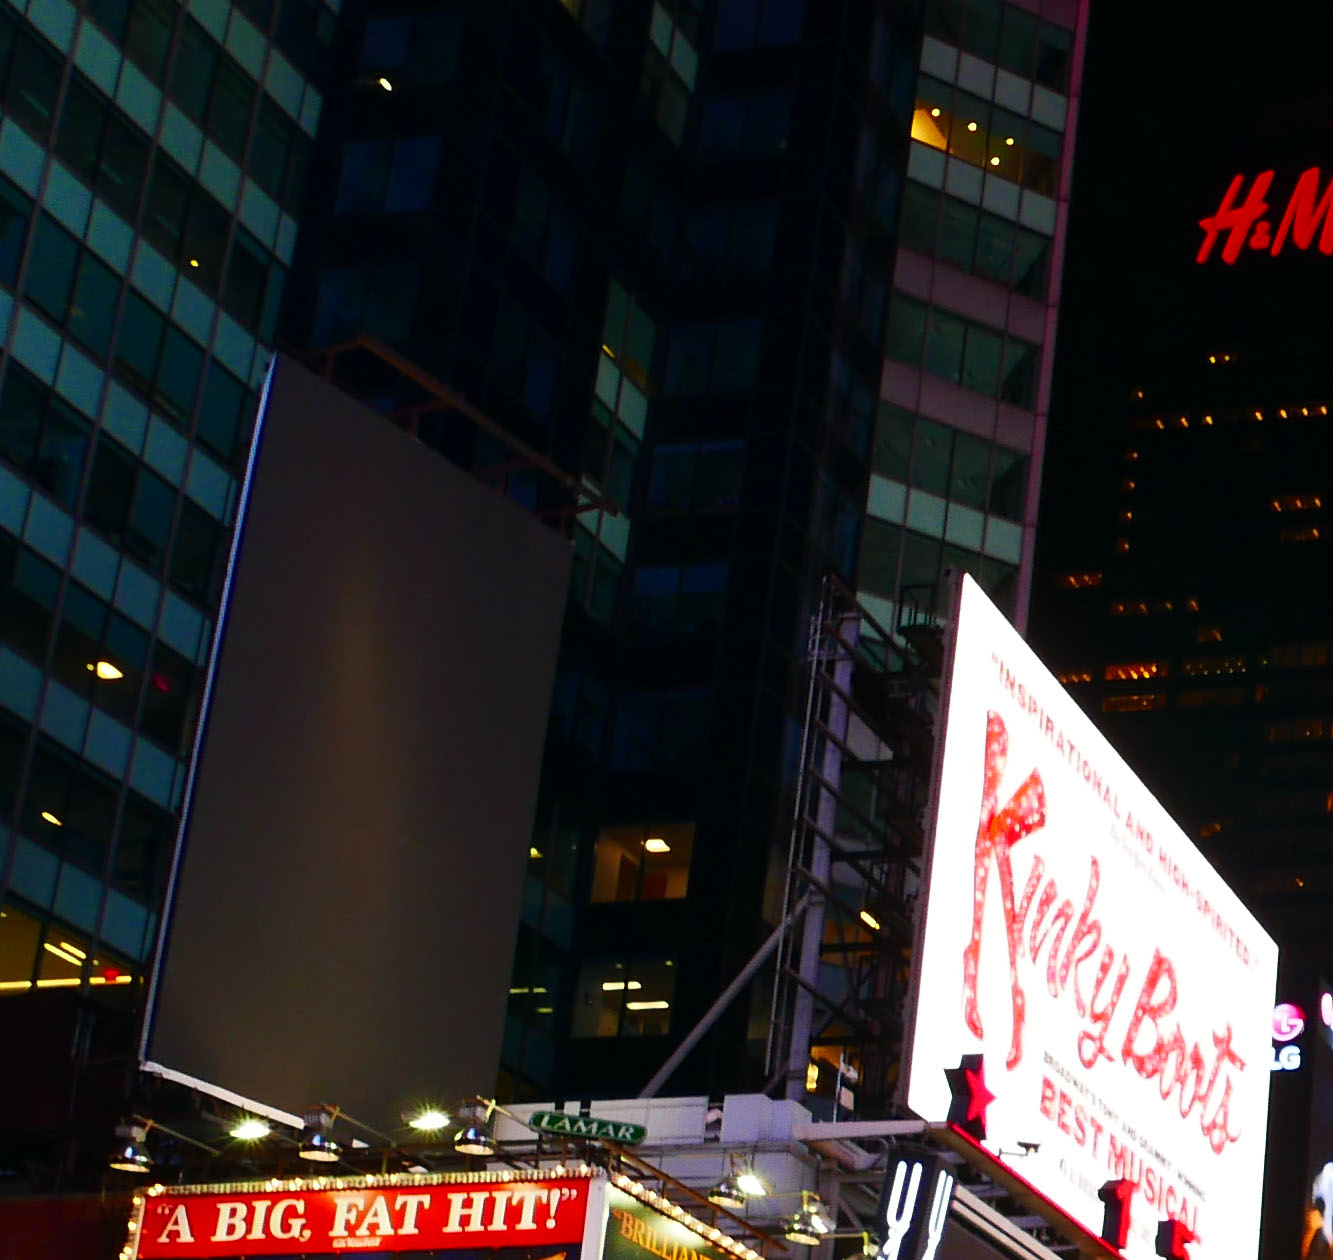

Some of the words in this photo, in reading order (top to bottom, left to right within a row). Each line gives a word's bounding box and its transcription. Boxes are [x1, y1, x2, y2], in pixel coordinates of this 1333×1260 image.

[1125, 811, 1154, 855] AND
[963, 709, 1130, 1071] Kinky
[1119, 946, 1246, 1156] Boots
[540, 1112, 636, 1141] LAMAR
[1039, 1073, 1103, 1160] BEST
[1107, 1133, 1202, 1246] MUSICAL
[210, 1198, 313, 1244] BIG,
[328, 1193, 432, 1238] FAT
